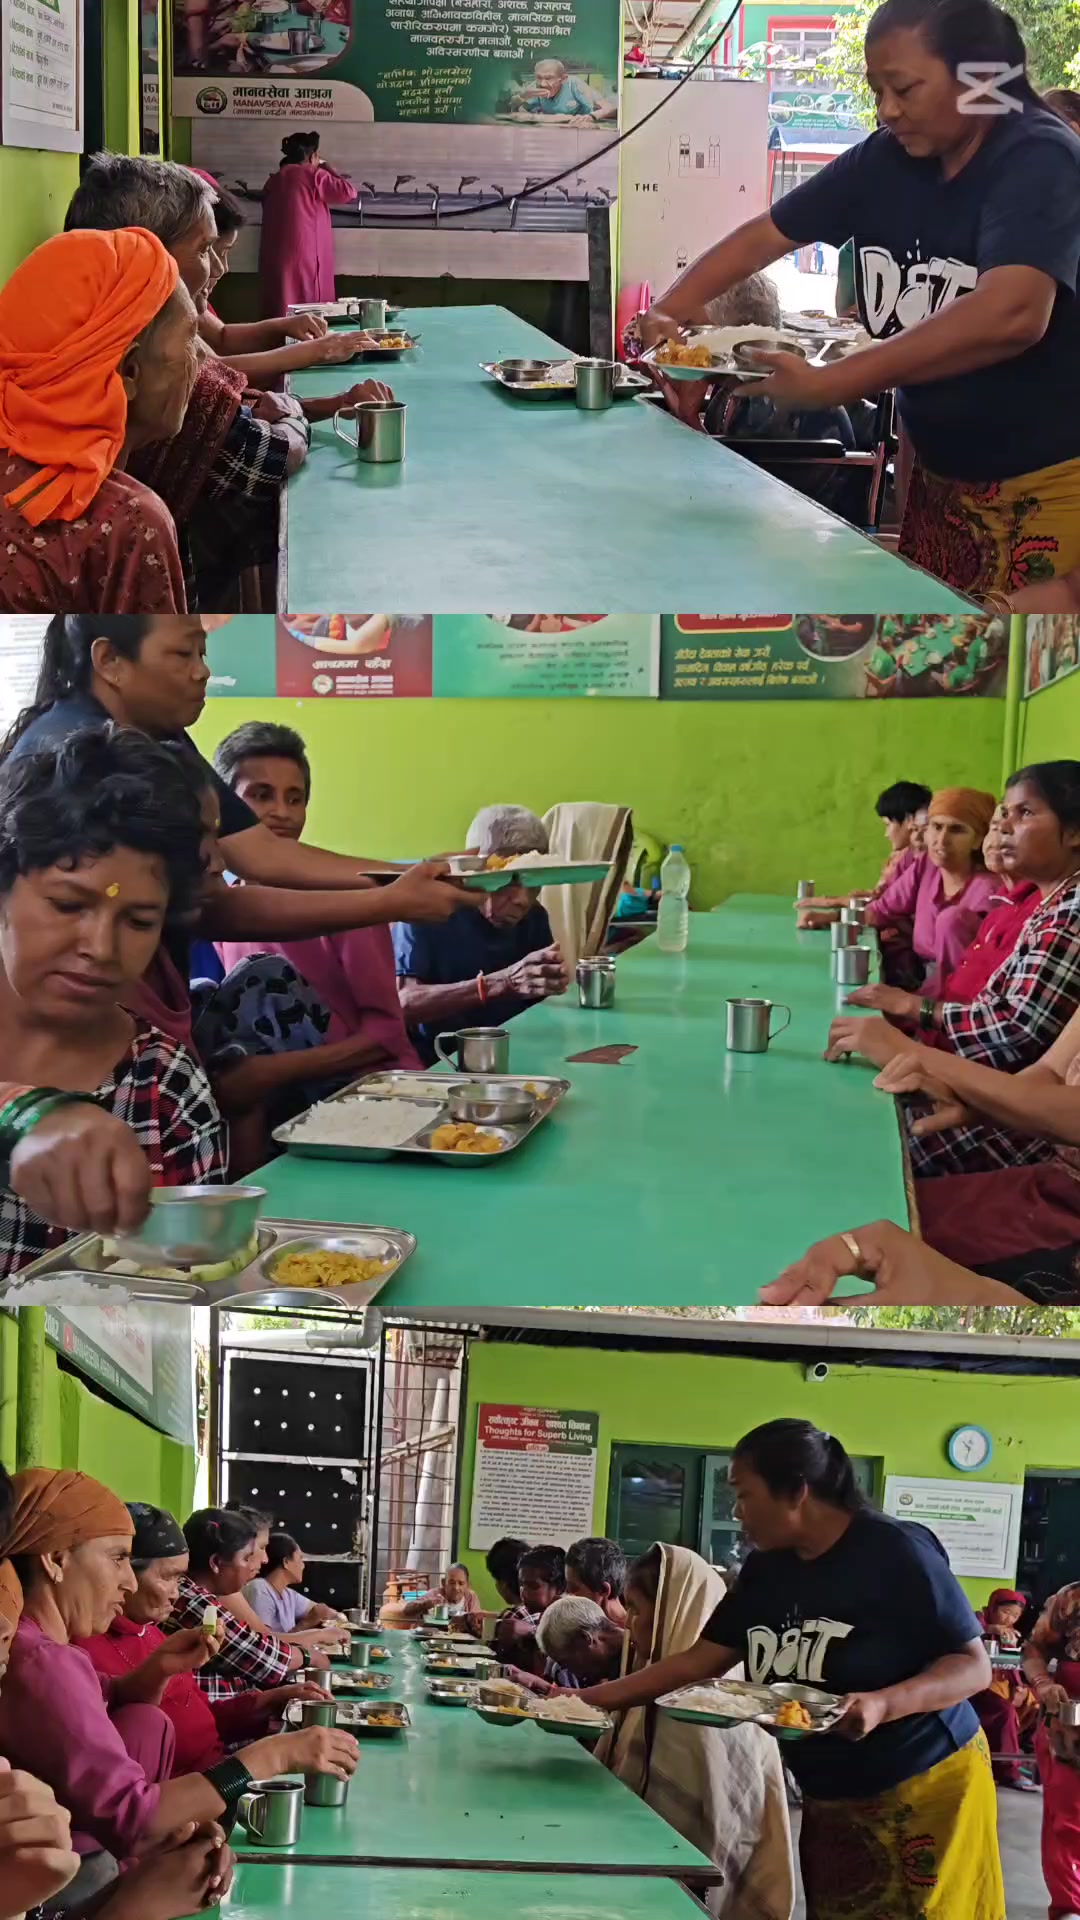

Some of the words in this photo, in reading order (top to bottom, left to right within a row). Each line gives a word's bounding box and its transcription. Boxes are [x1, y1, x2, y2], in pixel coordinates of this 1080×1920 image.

[385, 9, 416, 18] अनाथ,
[421, 9, 503, 21] अभिभावकविहीन,
[508, 12, 552, 23] मानसिक
[557, 14, 576, 24] तथा
[466, 22, 509, 34] कमजोर)
[426, 47, 489, 58] अविस्मरणीय
[232, 85, 290, 99] मानवसेवा
[294, 87, 332, 100] आश्रम
[233, 99, 292, 108] MANAVSEWA
[295, 100, 334, 109] ASHRAM
[634, 183, 659, 192] THE
[738, 184, 746, 193] A
[484, 1426, 522, 1438] Thoughts
[524, 1428, 536, 1437] for
[537, 1430, 567, 1441] Superb
[568, 1431, 593, 1443] Living
